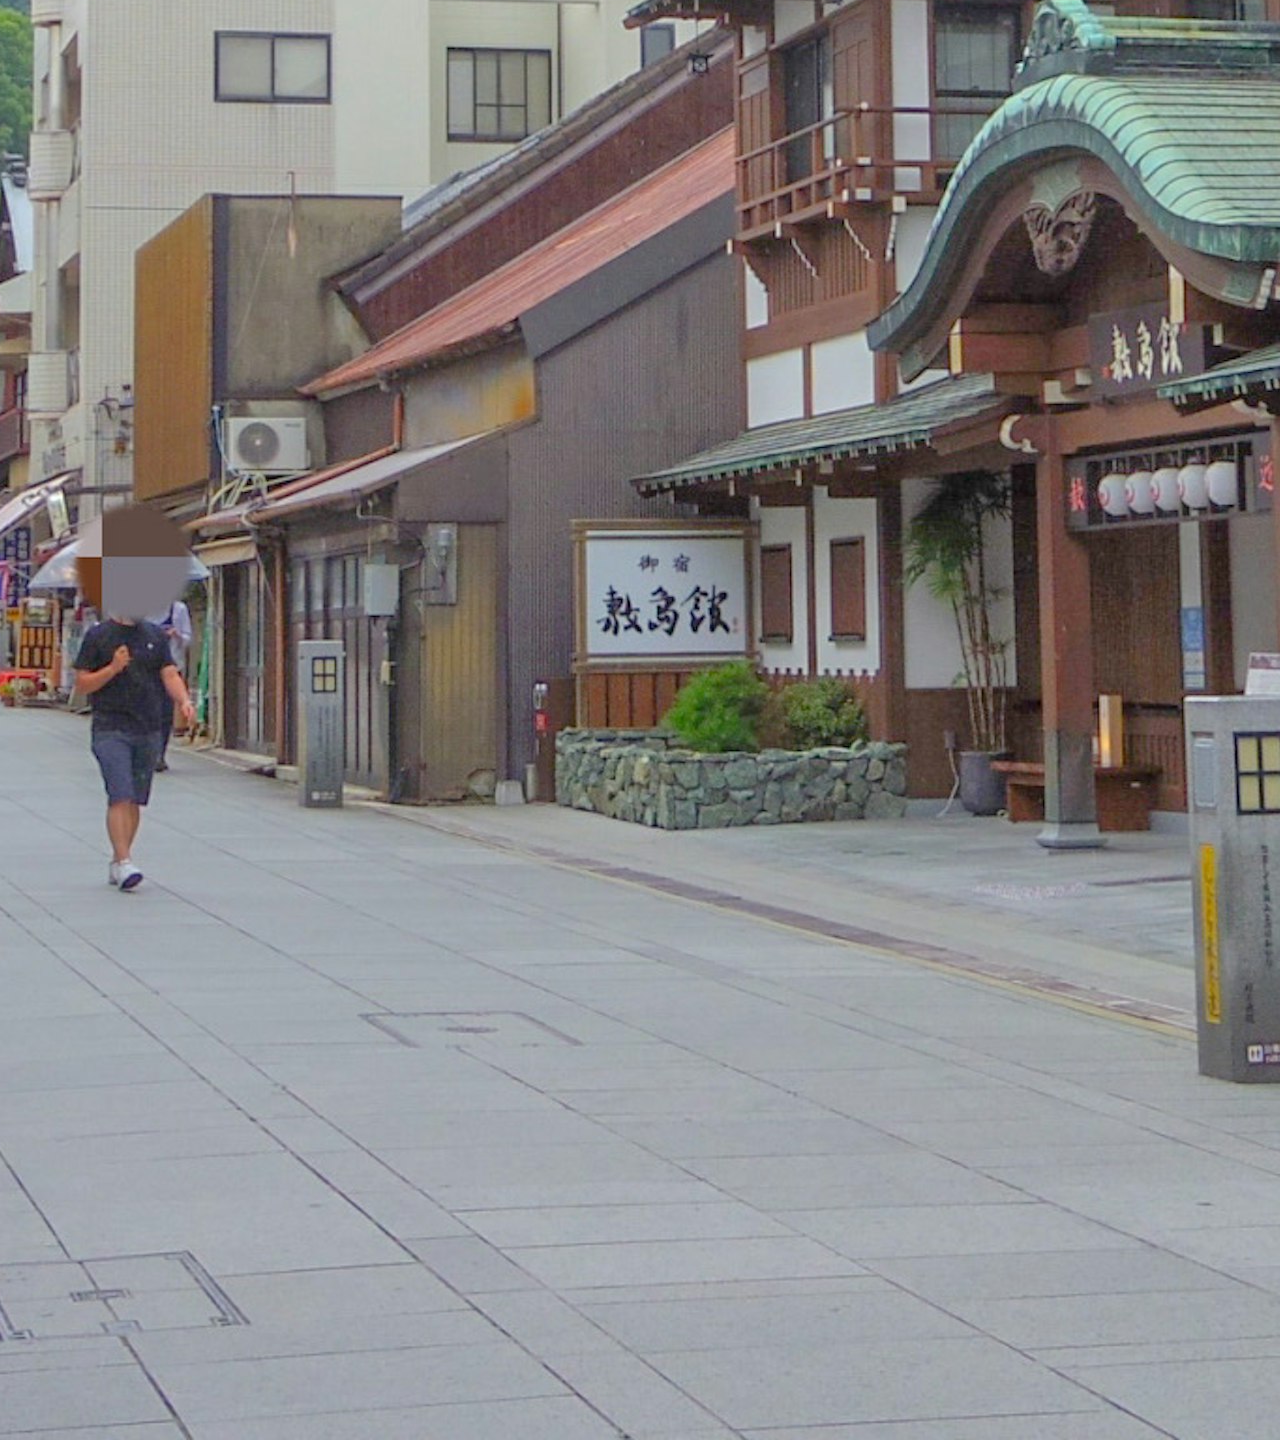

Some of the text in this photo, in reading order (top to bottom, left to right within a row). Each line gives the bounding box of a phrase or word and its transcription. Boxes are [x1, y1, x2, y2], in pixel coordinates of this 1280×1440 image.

[637, 553, 692, 574] 御宿
[596, 583, 731, 637] 敷島館
